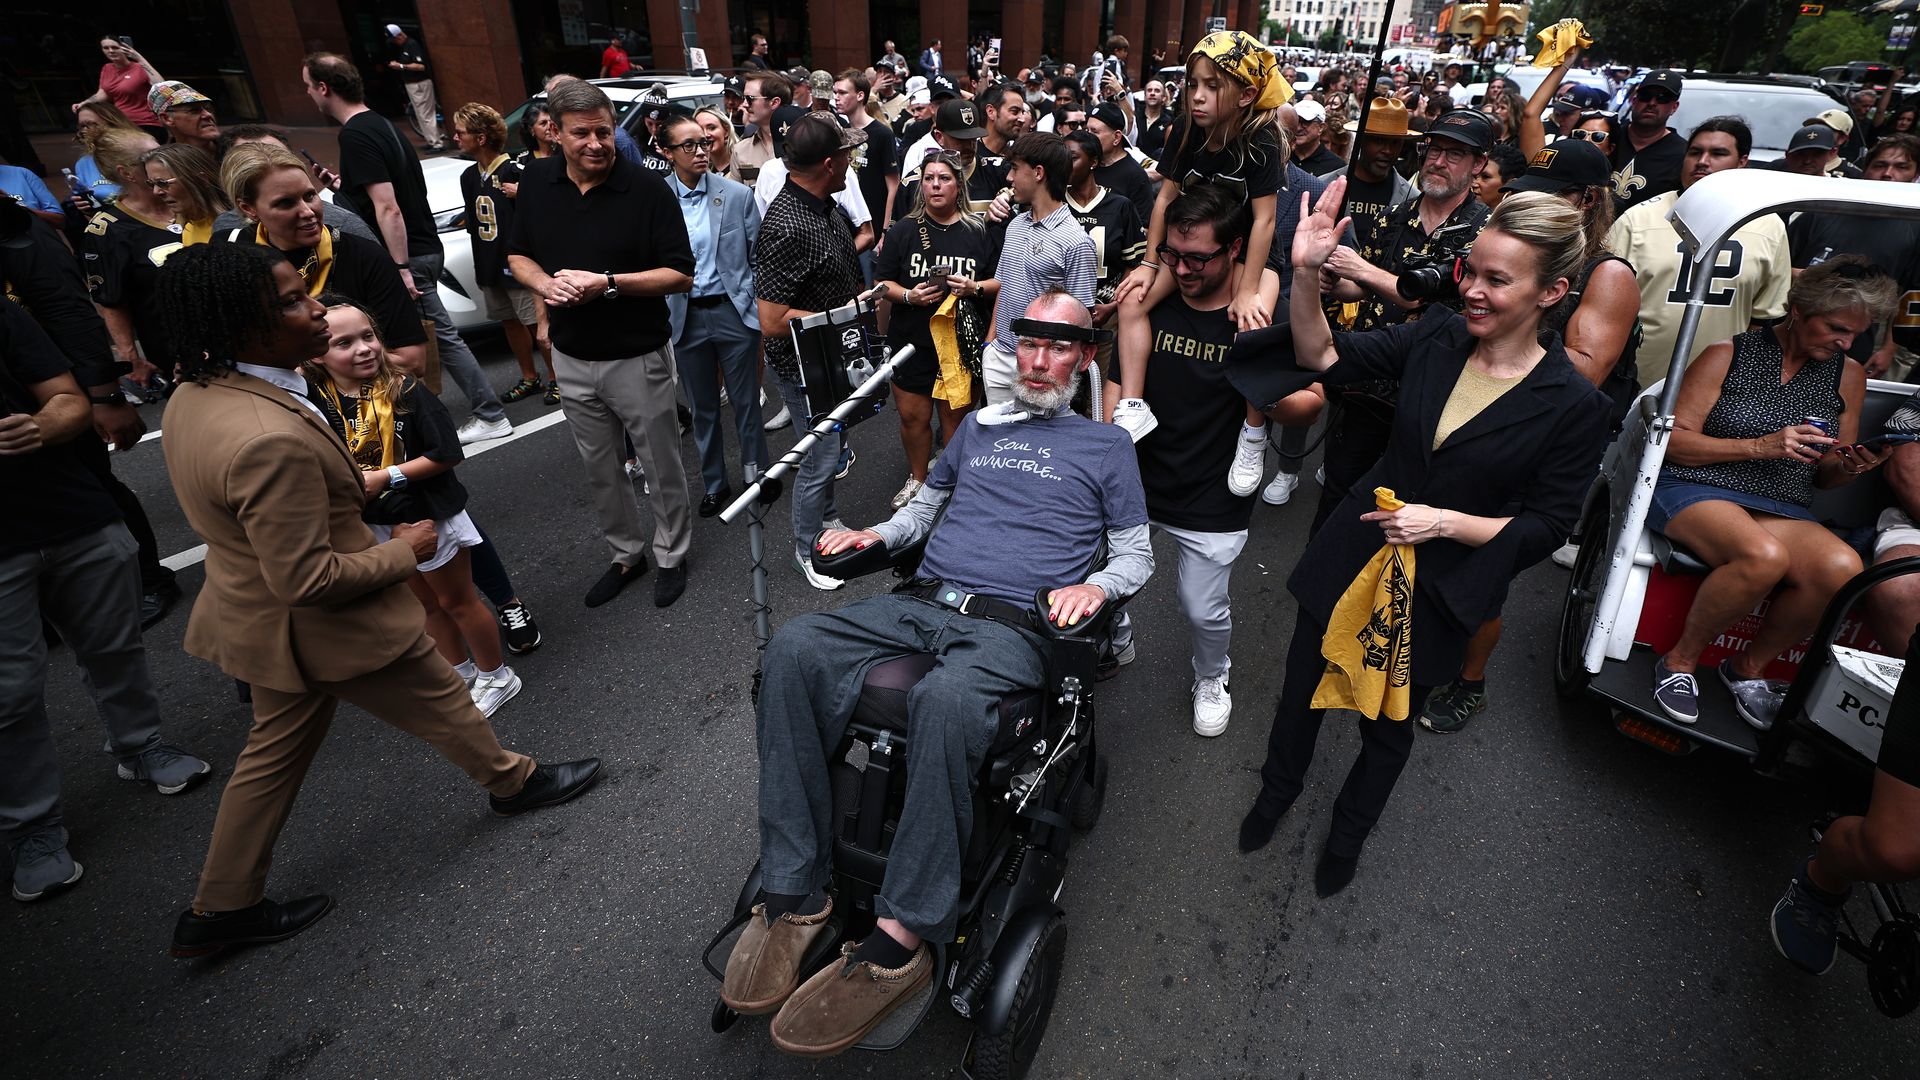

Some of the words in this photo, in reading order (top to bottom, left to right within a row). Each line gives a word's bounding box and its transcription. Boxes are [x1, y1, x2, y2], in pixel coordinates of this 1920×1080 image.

[642, 158, 657, 170] HO
[475, 195, 499, 241] 9
[1349, 201, 1388, 215] EBIRT
[1077, 216, 1098, 225] AINTS
[909, 252, 977, 282] SAINTS
[1666, 239, 1744, 307] 12
[1154, 329, 1233, 363] [REBIRT
[1127, 400, 1143, 409] SPX
[993, 437, 1033, 453] SOUL
[1037, 446, 1052, 459] IS
